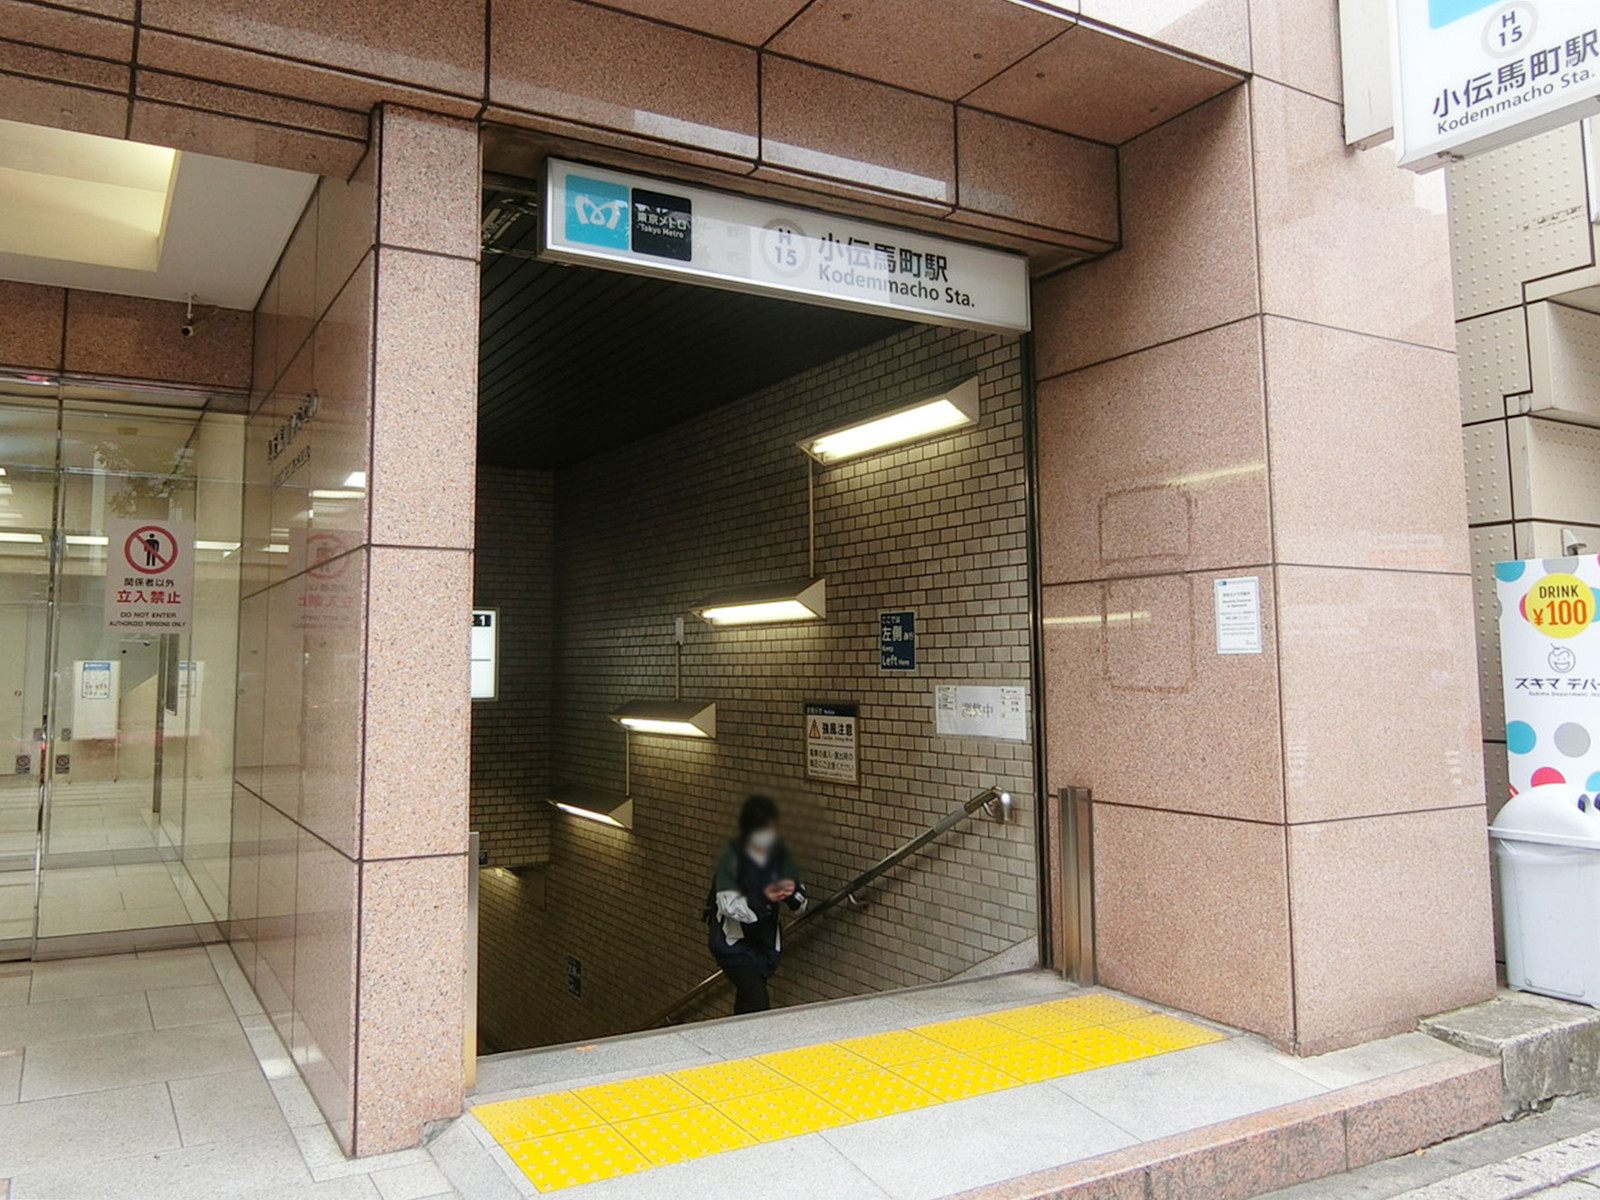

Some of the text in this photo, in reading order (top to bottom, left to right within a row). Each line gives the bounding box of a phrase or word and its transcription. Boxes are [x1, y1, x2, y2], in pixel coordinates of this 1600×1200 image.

[1501, 10, 1516, 29] H
[1498, 25, 1523, 47] 15
[1432, 28, 1600, 119] 小伝馬町駅
[1437, 69, 1596, 135] Kodemmacho Sta.
[637, 211, 688, 231] 東京メトロ
[638, 222, 685, 239] Tokyo Metro
[778, 228, 792, 246] H
[774, 245, 798, 267] 15
[818, 232, 949, 283] 小伝馬町駅
[819, 263, 976, 308] Kodemmacho Sta.
[123, 577, 175, 588] 関係者以外
[1539, 584, 1580, 600] DRINK
[116, 589, 182, 604] 立入禁止
[133, 611, 150, 619] NOT
[1532, 598, 1588, 627] ¥100
[882, 654, 898, 666] Left
[1514, 677, 1561, 690] スキマ
